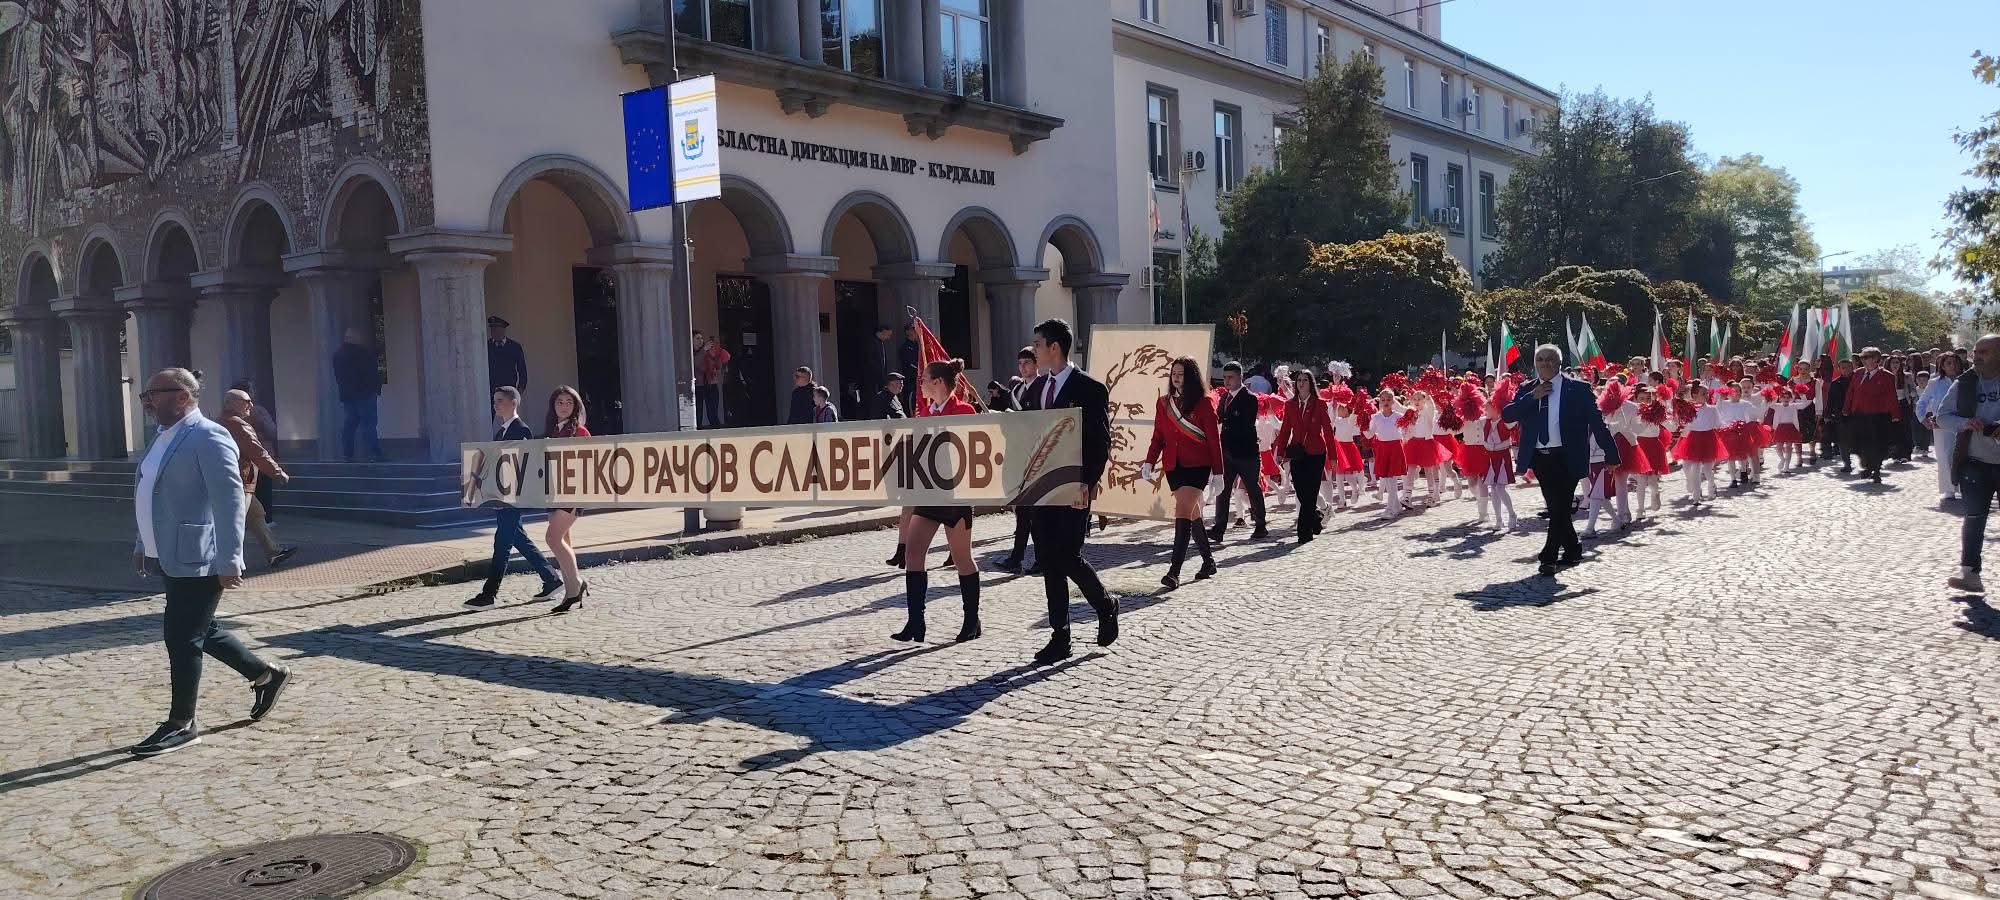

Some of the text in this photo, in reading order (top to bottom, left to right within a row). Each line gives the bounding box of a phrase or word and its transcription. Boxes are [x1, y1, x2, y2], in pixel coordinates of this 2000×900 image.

[717, 129, 788, 156] БЛАСТНА
[790, 140, 868, 168] ДИРЕКЦИЯ
[869, 152, 889, 171] НА
[890, 156, 917, 174] МВР
[928, 162, 996, 185] КЪРДЖАЛИ
[496, 452, 529, 497] СУ
[643, 442, 739, 495] РАЧОВ
